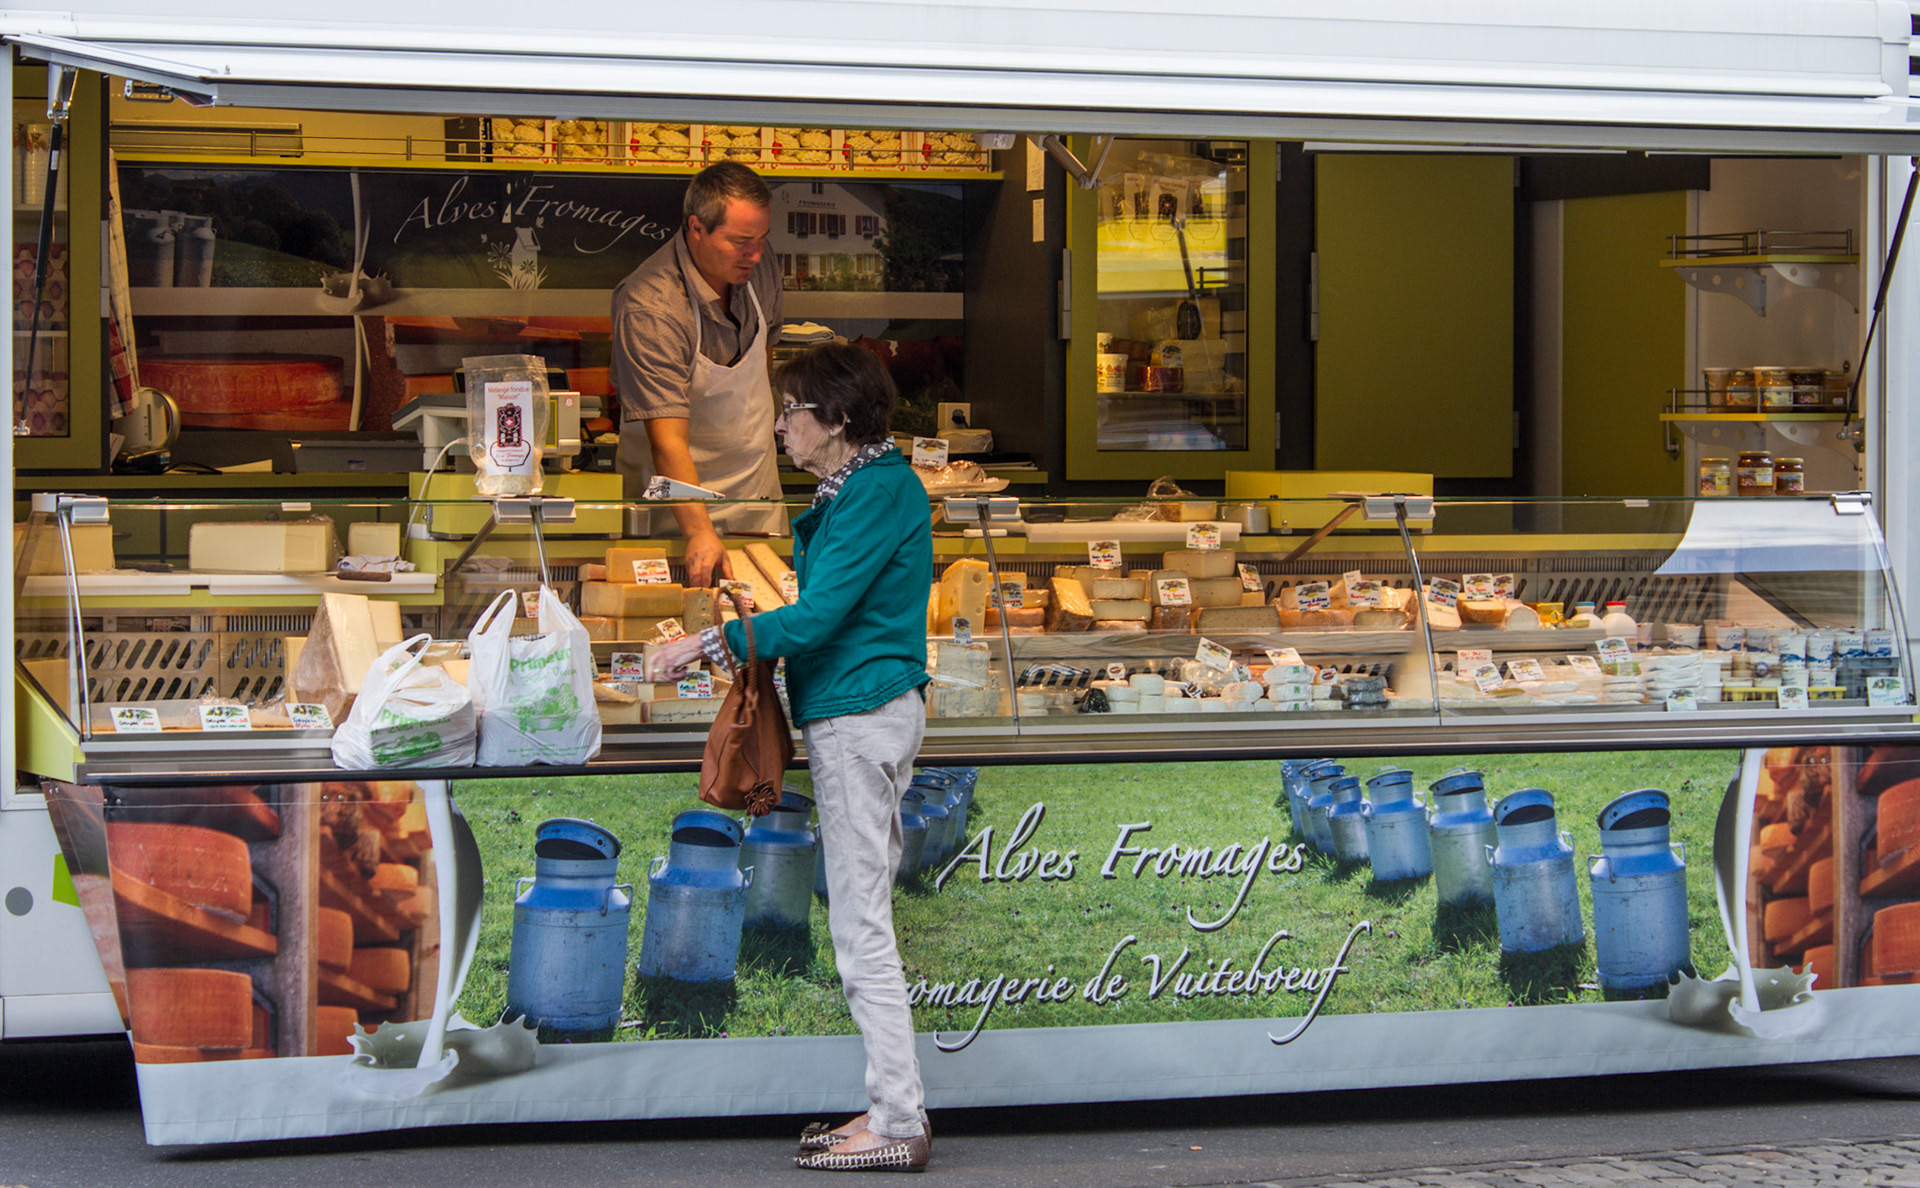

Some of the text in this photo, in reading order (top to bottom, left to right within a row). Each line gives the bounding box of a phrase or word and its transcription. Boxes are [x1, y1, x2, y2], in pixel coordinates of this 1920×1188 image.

[393, 175, 672, 255] Alves Fromages
[935, 800, 1306, 933] Alves Fromages
[905, 963, 1076, 1054] omagerie
[1083, 934, 1137, 1006] de
